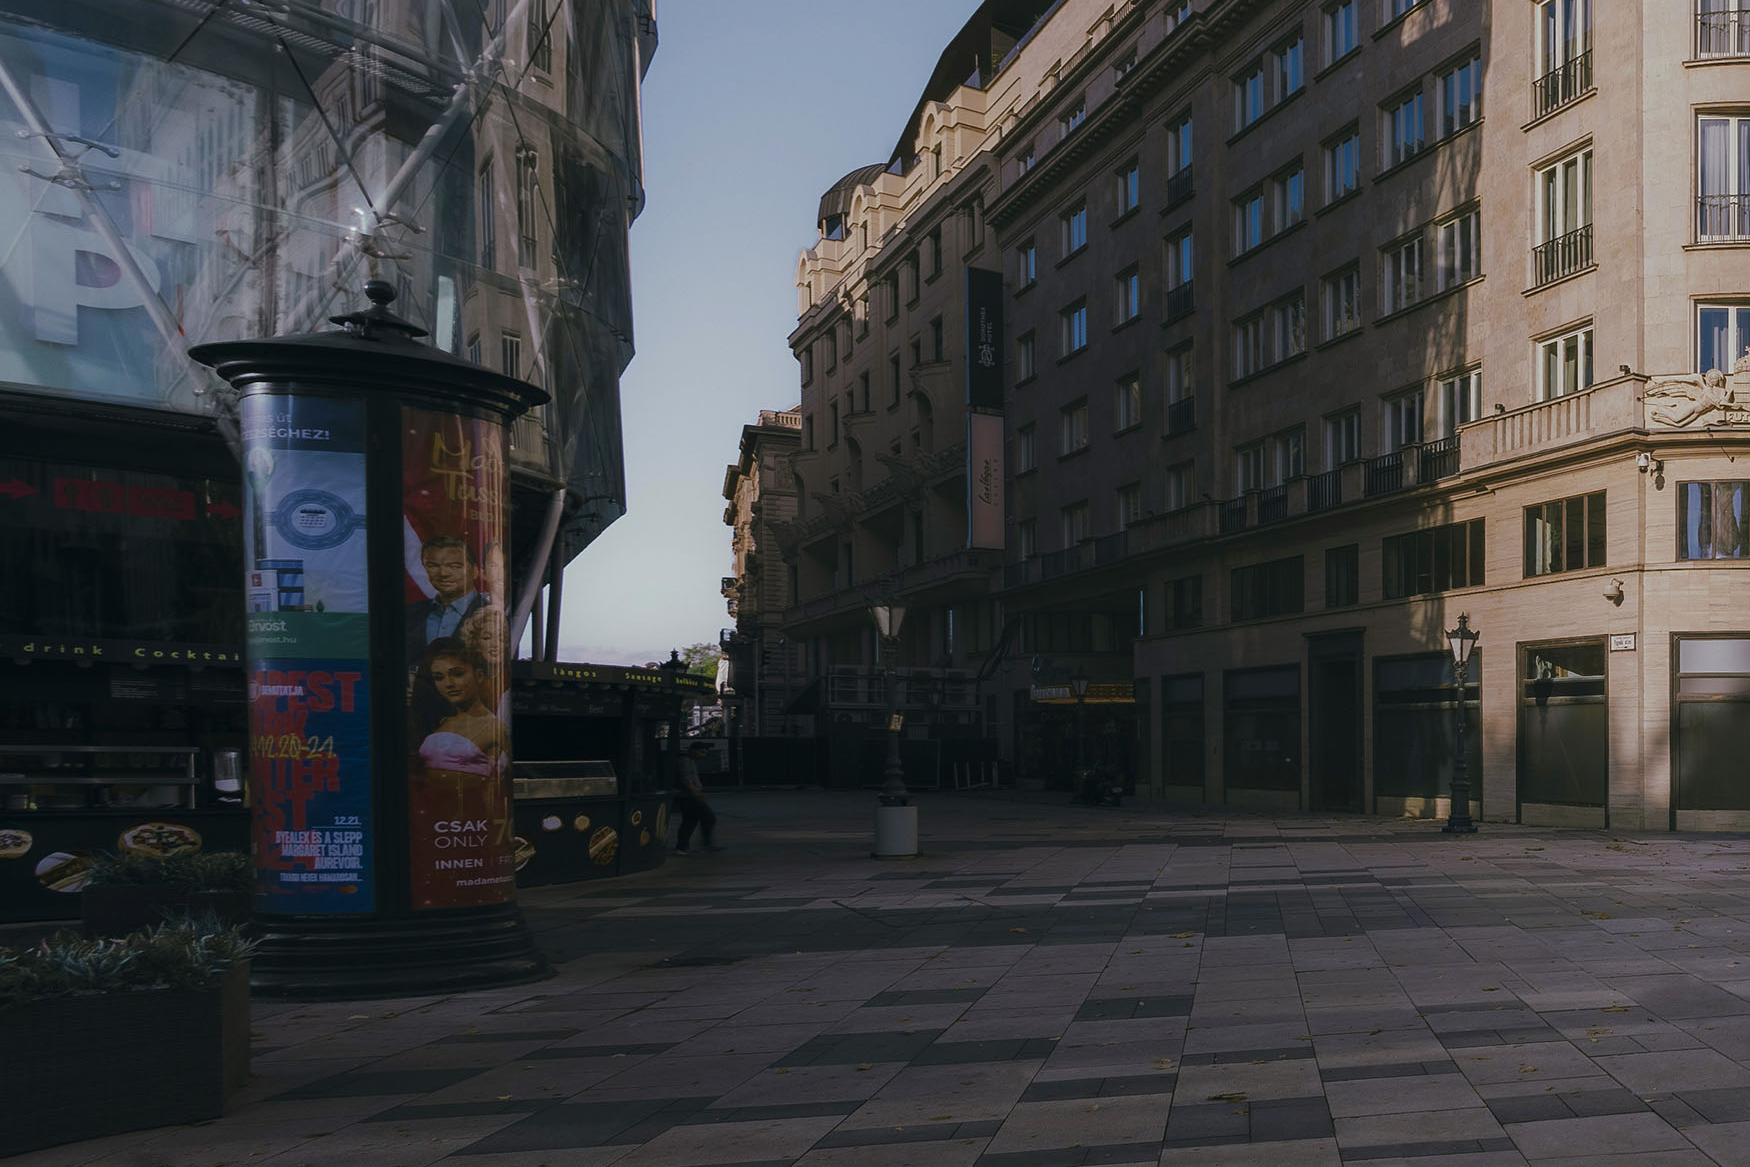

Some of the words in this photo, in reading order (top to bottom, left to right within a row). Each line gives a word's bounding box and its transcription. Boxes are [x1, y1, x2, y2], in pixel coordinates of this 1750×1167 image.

[23, 642, 103, 655] drink
[134, 647, 241, 661] Cocktai
[625, 672, 663, 683] Sausage
[433, 819, 488, 833] CSAK
[324, 831, 331, 844] A
[333, 831, 363, 844] SLEPP
[434, 834, 488, 849] ONLY
[281, 844, 326, 856] MARGARET
[328, 844, 363, 856] ISLAND
[435, 858, 484, 870] INNEN
